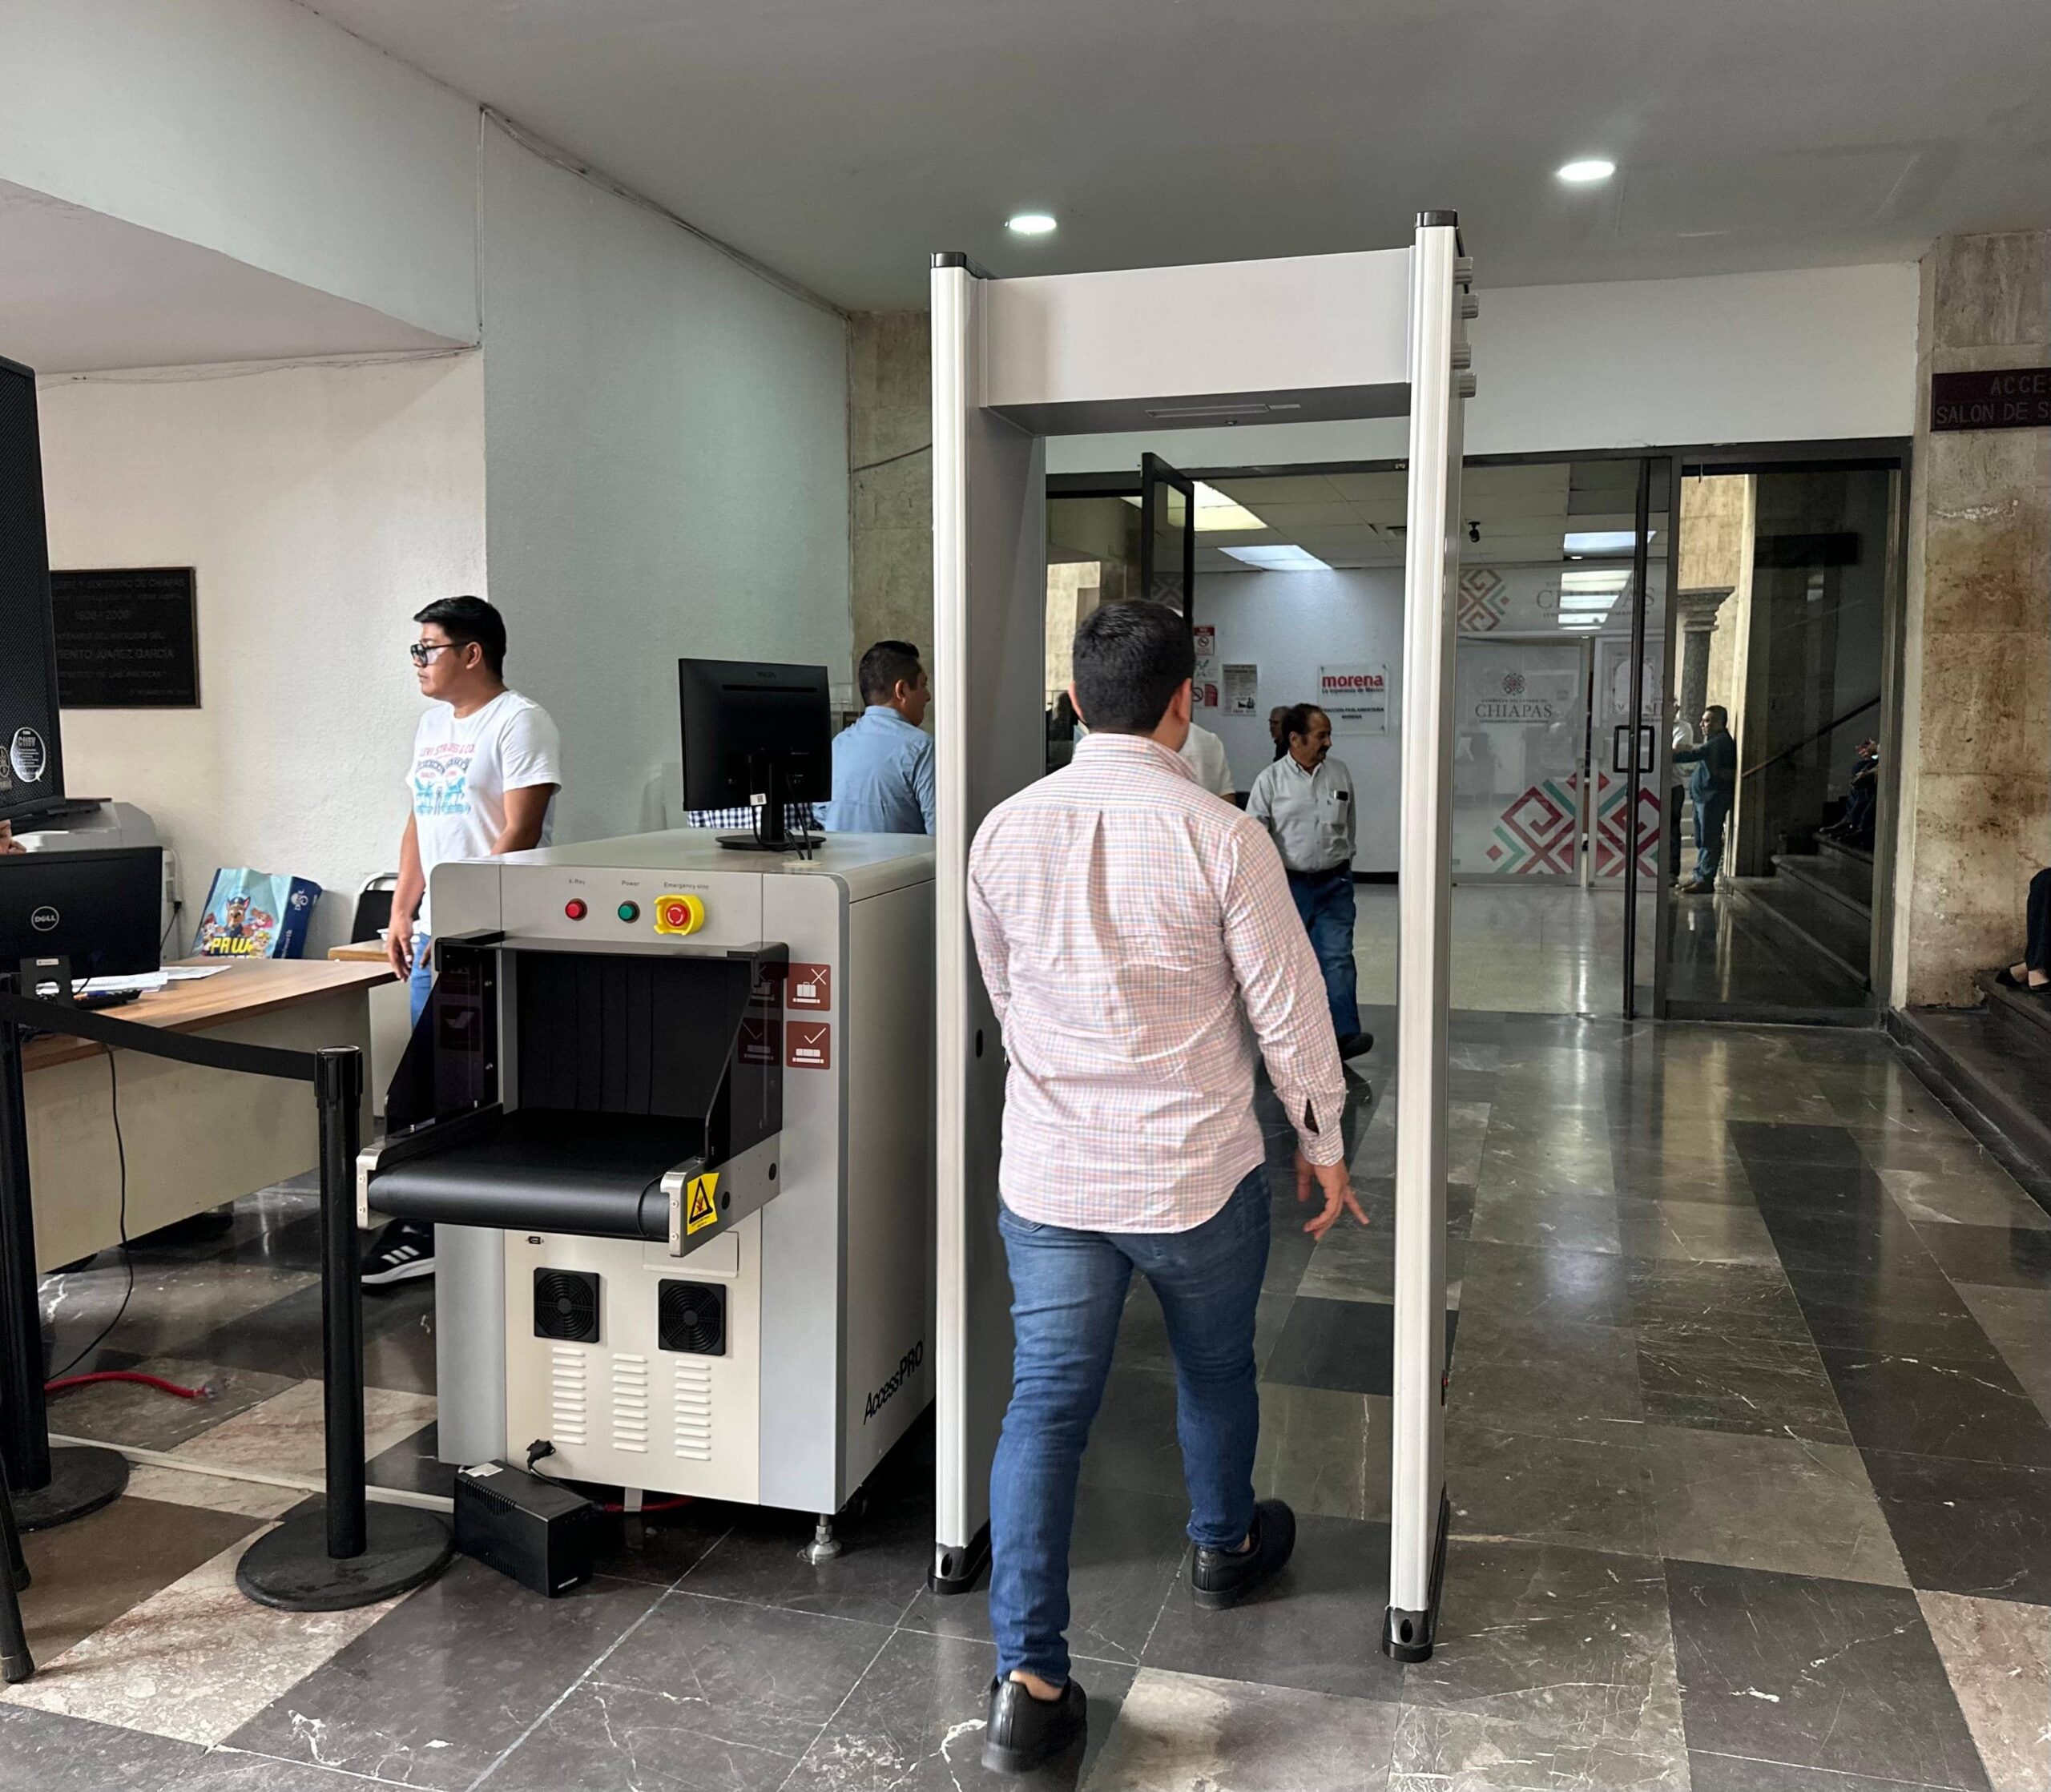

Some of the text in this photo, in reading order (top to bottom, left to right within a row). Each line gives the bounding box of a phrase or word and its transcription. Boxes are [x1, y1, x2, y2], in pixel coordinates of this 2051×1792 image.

[2004, 401, 2029, 421] DE
[2037, 401, 2051, 419] S
[1322, 675, 1384, 687] morena
[1475, 703, 1553, 719] CHIAPAS
[663, 881, 696, 891] Emergency
[34, 915, 57, 923] DELL
[211, 936, 251, 954] PAW
[863, 1339, 924, 1426] AccessPRO
